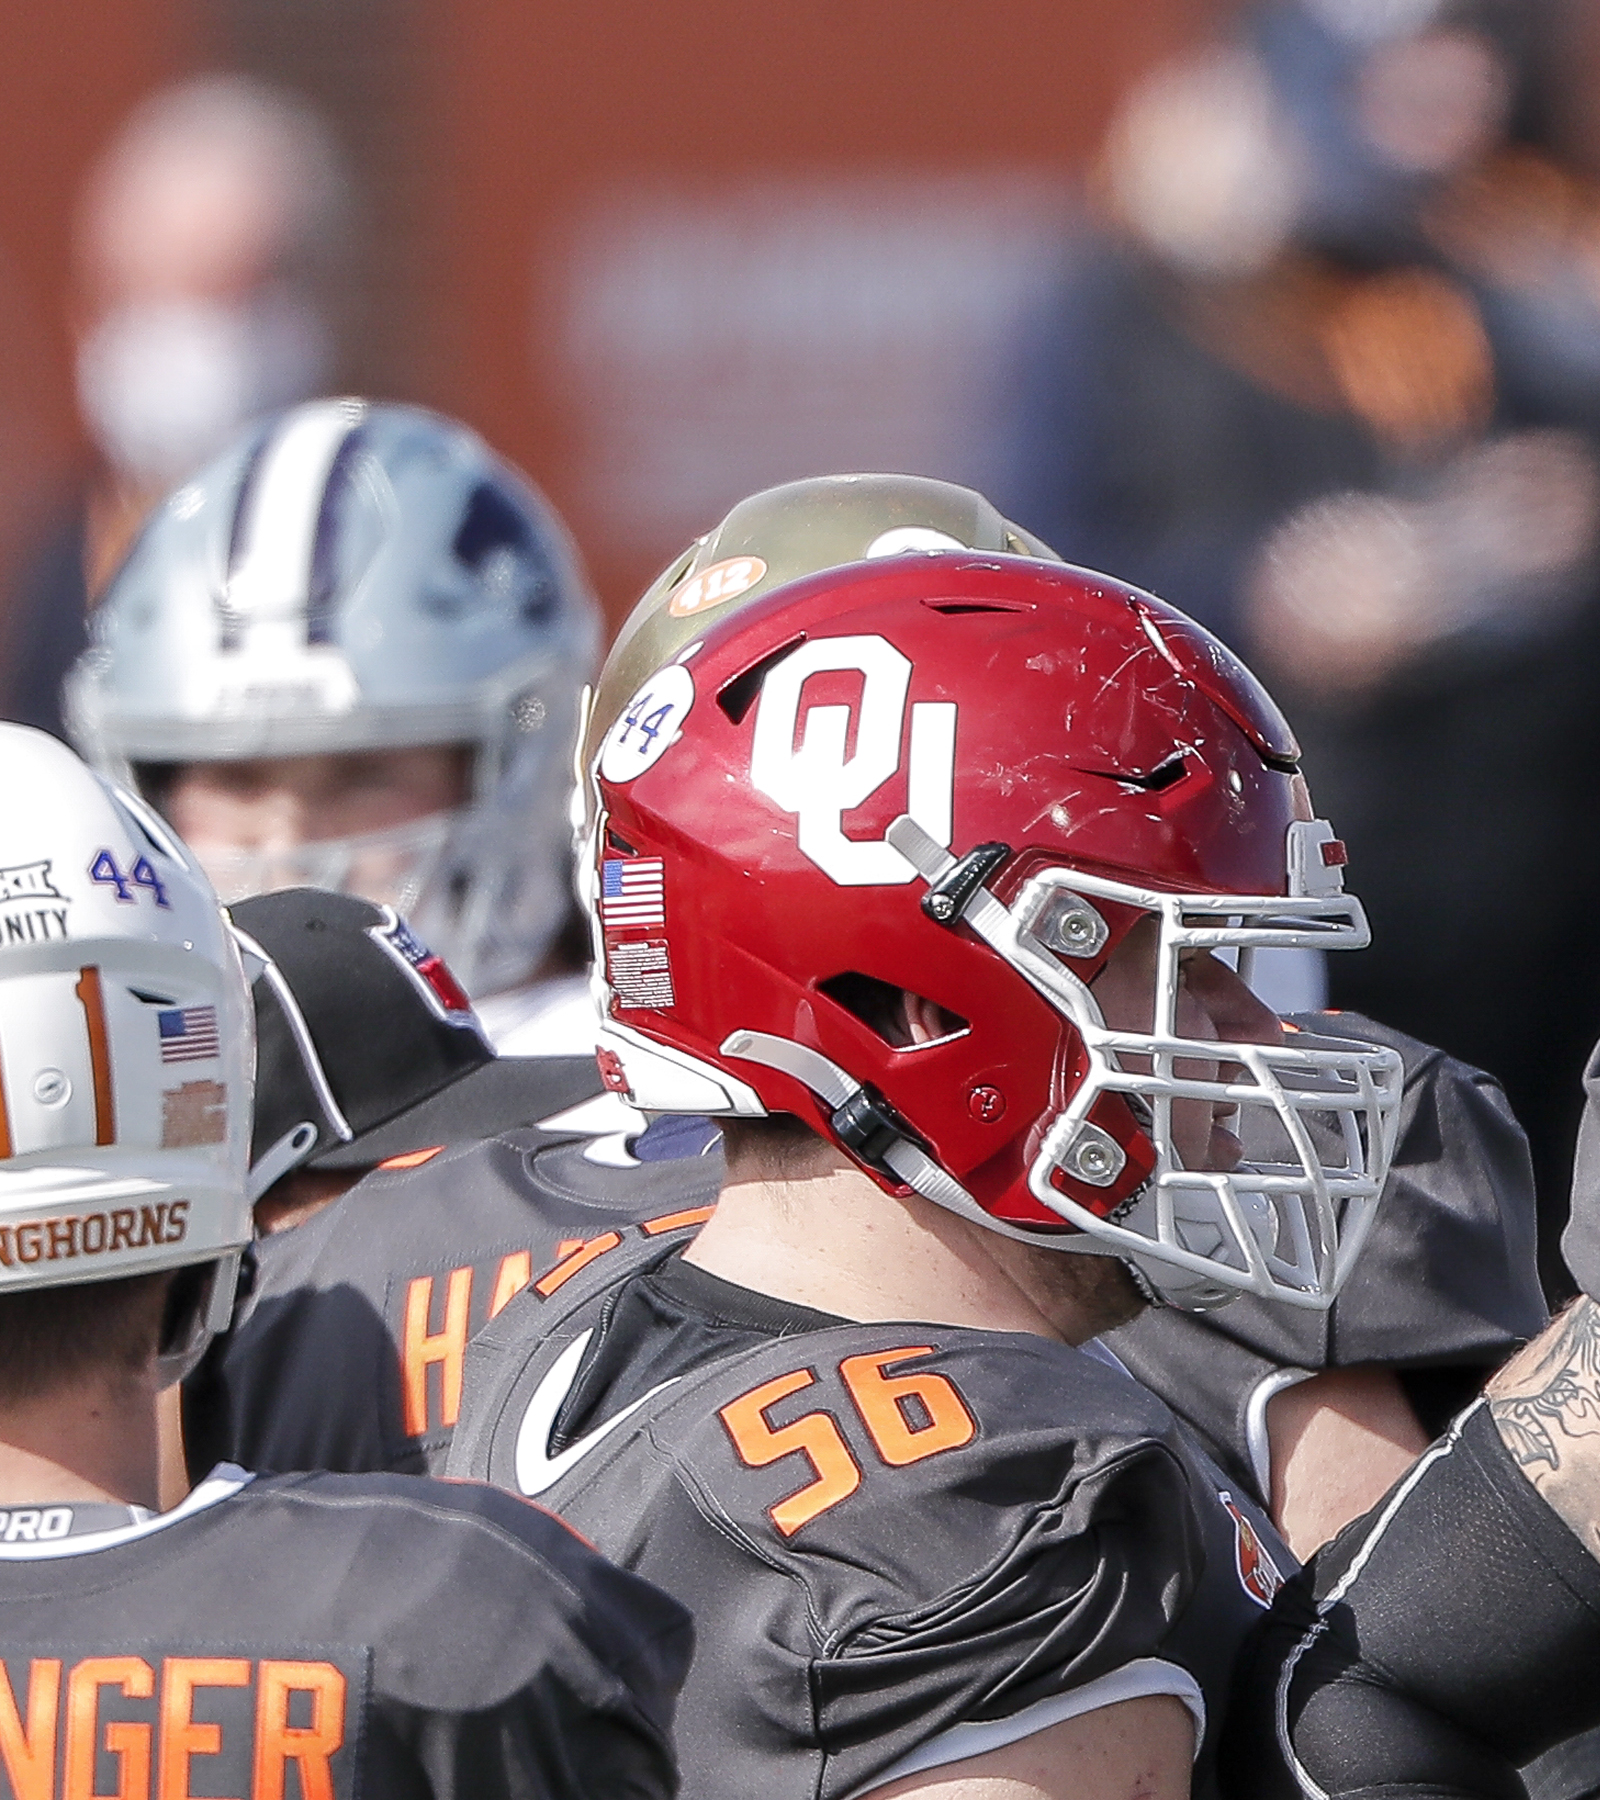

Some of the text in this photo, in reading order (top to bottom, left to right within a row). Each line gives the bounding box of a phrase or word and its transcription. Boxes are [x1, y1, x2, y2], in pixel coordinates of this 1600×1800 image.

[678, 560, 754, 611] 412
[617, 692, 676, 755] 44
[750, 634, 958, 887] OU
[88, 848, 174, 912] 44
[0, 907, 69, 943] NITY
[717, 1344, 978, 1538] 56
